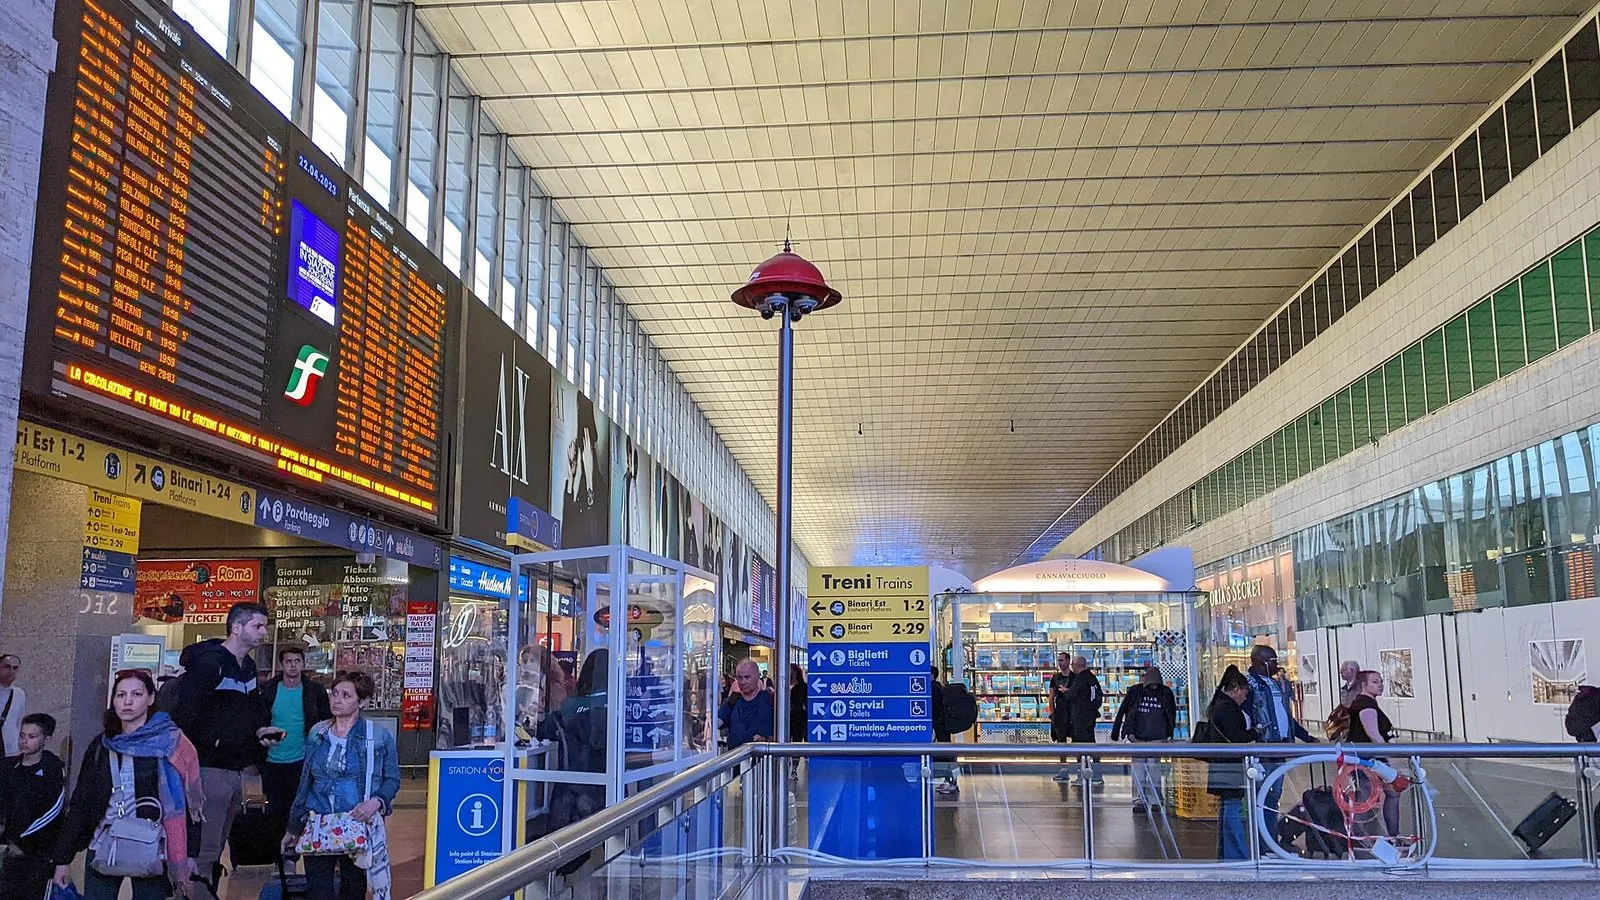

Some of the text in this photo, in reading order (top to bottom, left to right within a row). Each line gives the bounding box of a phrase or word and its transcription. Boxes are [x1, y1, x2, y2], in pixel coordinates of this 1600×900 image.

[159, 18, 182, 46] Arrivals
[133, 53, 154, 78] TORINO
[131, 68, 154, 94] NAPOLI
[128, 100, 160, 132] FIUMICINO
[127, 116, 154, 144] VENEZIA
[126, 133, 149, 156] MILANO
[124, 165, 148, 188] ALBANO
[150, 183, 164, 200] LAZ.
[298, 155, 337, 196] 22.04.2023
[120, 196, 144, 220] MILANO
[348, 187, 370, 215] Partenze
[120, 213, 150, 242] FIUMICINO
[118, 230, 142, 254] NAPOLI
[116, 246, 133, 264] PISA
[116, 262, 139, 284] MILANO
[114, 280, 139, 300] ANCONA
[112, 296, 142, 320] SALERNO
[111, 314, 144, 337] FIUMICINO
[110, 330, 142, 353] VELLETRI
[70, 366, 82, 380] LA
[84, 371, 132, 400] CIRCOLAZIONE
[134, 390, 148, 405] DEI
[149, 396, 168, 413] TRENI
[169, 404, 181, 418] TRA
[182, 408, 192, 422] LE
[192, 412, 218, 432] STAZIONI
[218, 422, 226, 434] DI
[226, 426, 252, 444] AVEZZANO
[490, 352, 529, 485] AX
[33, 430, 54, 453] Est
[62, 438, 85, 461] 1-2
[21, 450, 61, 472] Platforms
[170, 470, 230, 500] Binari 1-24
[93, 491, 131, 510] Treni Trains
[169, 489, 197, 506] Platforms
[286, 502, 330, 528] Parcheggio
[284, 520, 301, 535] Parking
[218, 564, 253, 582] Roma
[277, 568, 312, 576] Giornali
[344, 565, 377, 574] Tickets
[276, 578, 308, 586] Riviste
[342, 585, 369, 594] Metro
[478, 570, 504, 594] Hudson
[822, 574, 912, 590] Treni Trains
[1232, 578, 1262, 602] SECRET
[202, 590, 214, 598] Hop
[216, 590, 225, 598] On
[230, 589, 242, 598] Hop
[244, 588, 254, 598] Off
[276, 588, 320, 598] Souvenirs
[276, 597, 320, 606] Giocattoli
[342, 594, 368, 602] Treno
[276, 609, 312, 620] Biglietti
[342, 604, 360, 612] Bus
[185, 614, 224, 623] TICKET
[276, 619, 325, 629] Roma Pass
[848, 650, 888, 660] Biglietti
[848, 700, 884, 710] Servizi
[849, 710, 870, 718] Toilets
[848, 724, 927, 733] Fiumicino Aeroporto
[448, 766, 480, 774] STATION
[482, 766, 487, 774] 4
[460, 850, 474, 859] point
